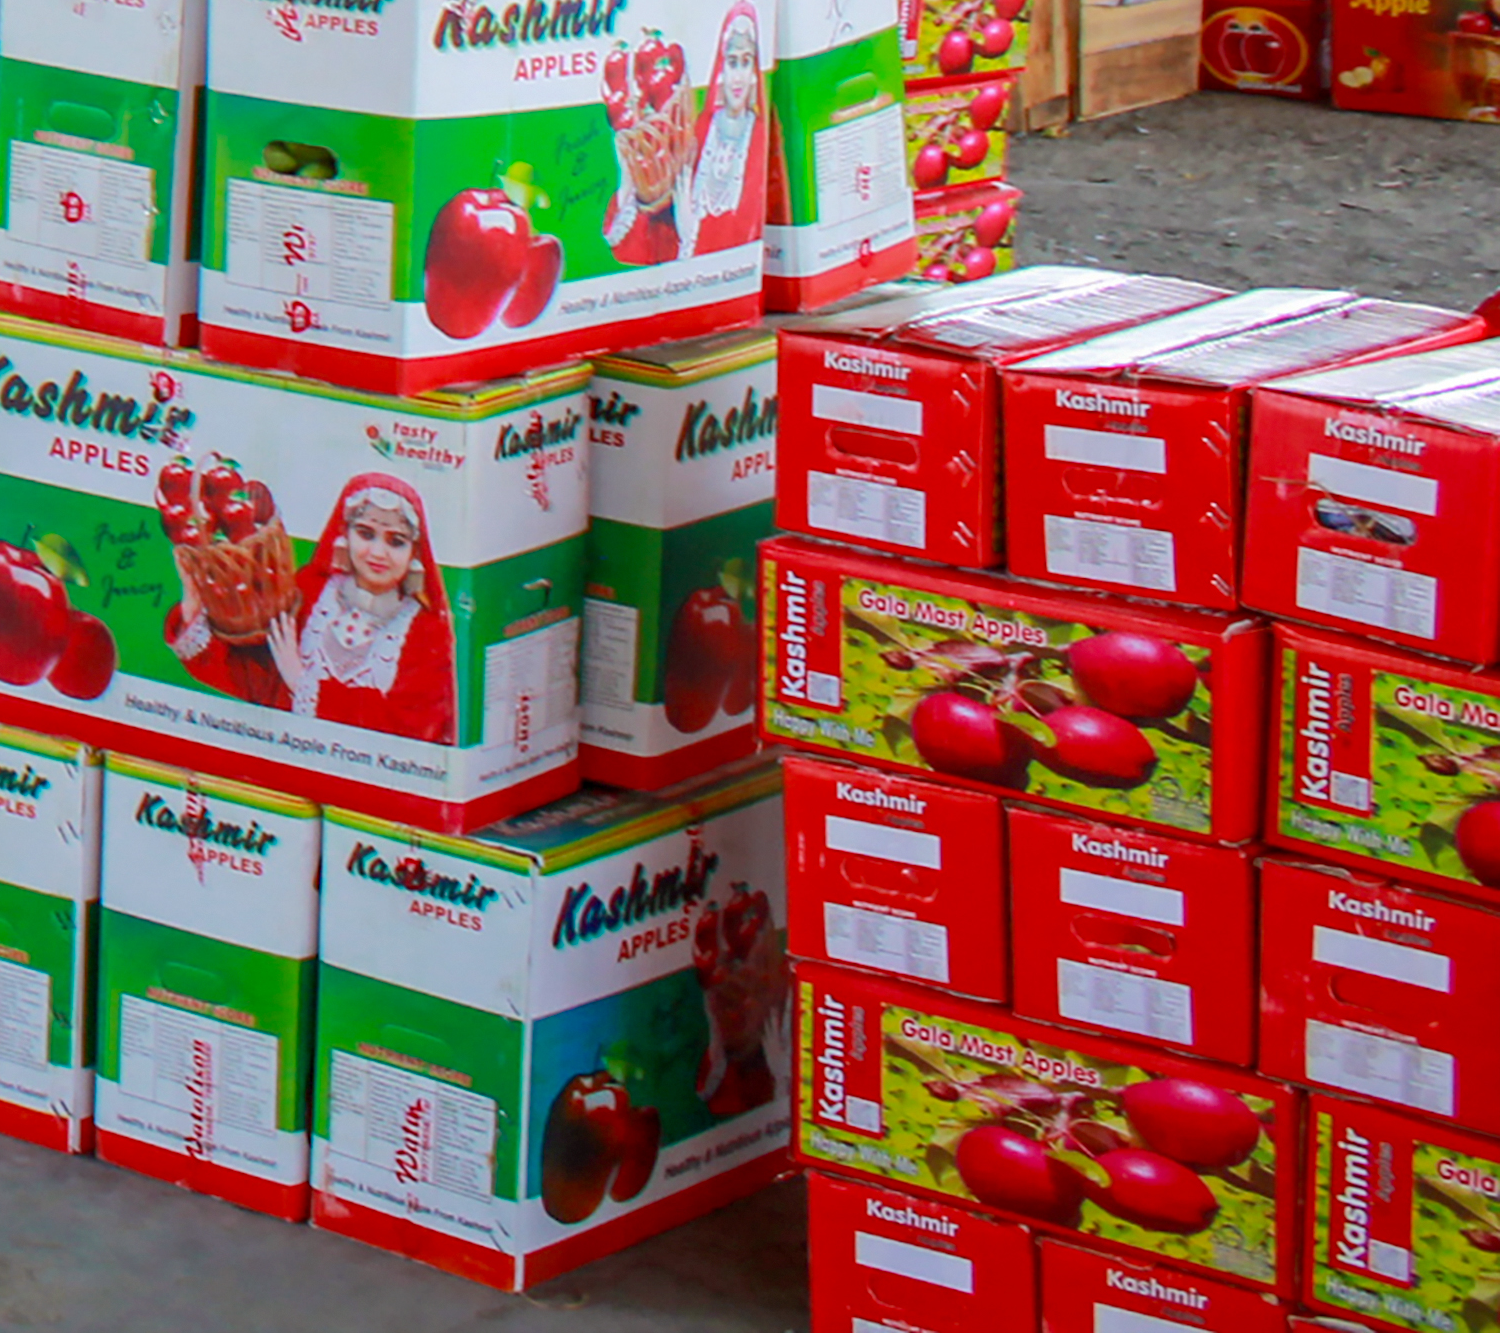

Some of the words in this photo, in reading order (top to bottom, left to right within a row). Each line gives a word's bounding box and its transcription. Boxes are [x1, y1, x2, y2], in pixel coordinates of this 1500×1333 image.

[305, 14, 379, 36] APPLES
[514, 51, 598, 81] APPLES
[824, 349, 911, 382] Kashmir
[1055, 388, 1151, 420] Kashmir
[393, 421, 438, 443] tasty
[1324, 416, 1427, 458] Kashmir
[47, 436, 151, 480] APPLES
[394, 442, 467, 471] healthy
[779, 570, 807, 700] Kashmir
[859, 589, 910, 618] Gala
[913, 601, 969, 633] Mast
[973, 614, 1046, 646] Apples
[1337, 672, 1354, 732] Apples
[1394, 686, 1451, 722] Gala
[123, 694, 181, 725] Healthy
[184, 710, 197, 727] &
[200, 713, 275, 746] Nutritious
[277, 731, 327, 758] Apple
[330, 742, 373, 767] From
[376, 751, 449, 784] Kashmir
[1301, 662, 1333, 800] Kashmir
[836, 782, 927, 815] Kashmir
[1072, 833, 1169, 869] Kashmir
[409, 898, 483, 933] APPLES
[1328, 889, 1436, 933] Kashmir
[617, 917, 691, 966] APPLES
[818, 994, 845, 1124] Kashmir
[901, 1016, 954, 1048] Gala
[959, 1029, 1017, 1066] Mast
[1022, 1048, 1099, 1088] Apples
[1376, 1140, 1395, 1203] Apples
[1436, 1158, 1498, 1196] Gala
[1337, 1127, 1371, 1266] Kashmir
[865, 1198, 959, 1238] Kashmir
[1106, 1268, 1208, 1310] Kashmir
